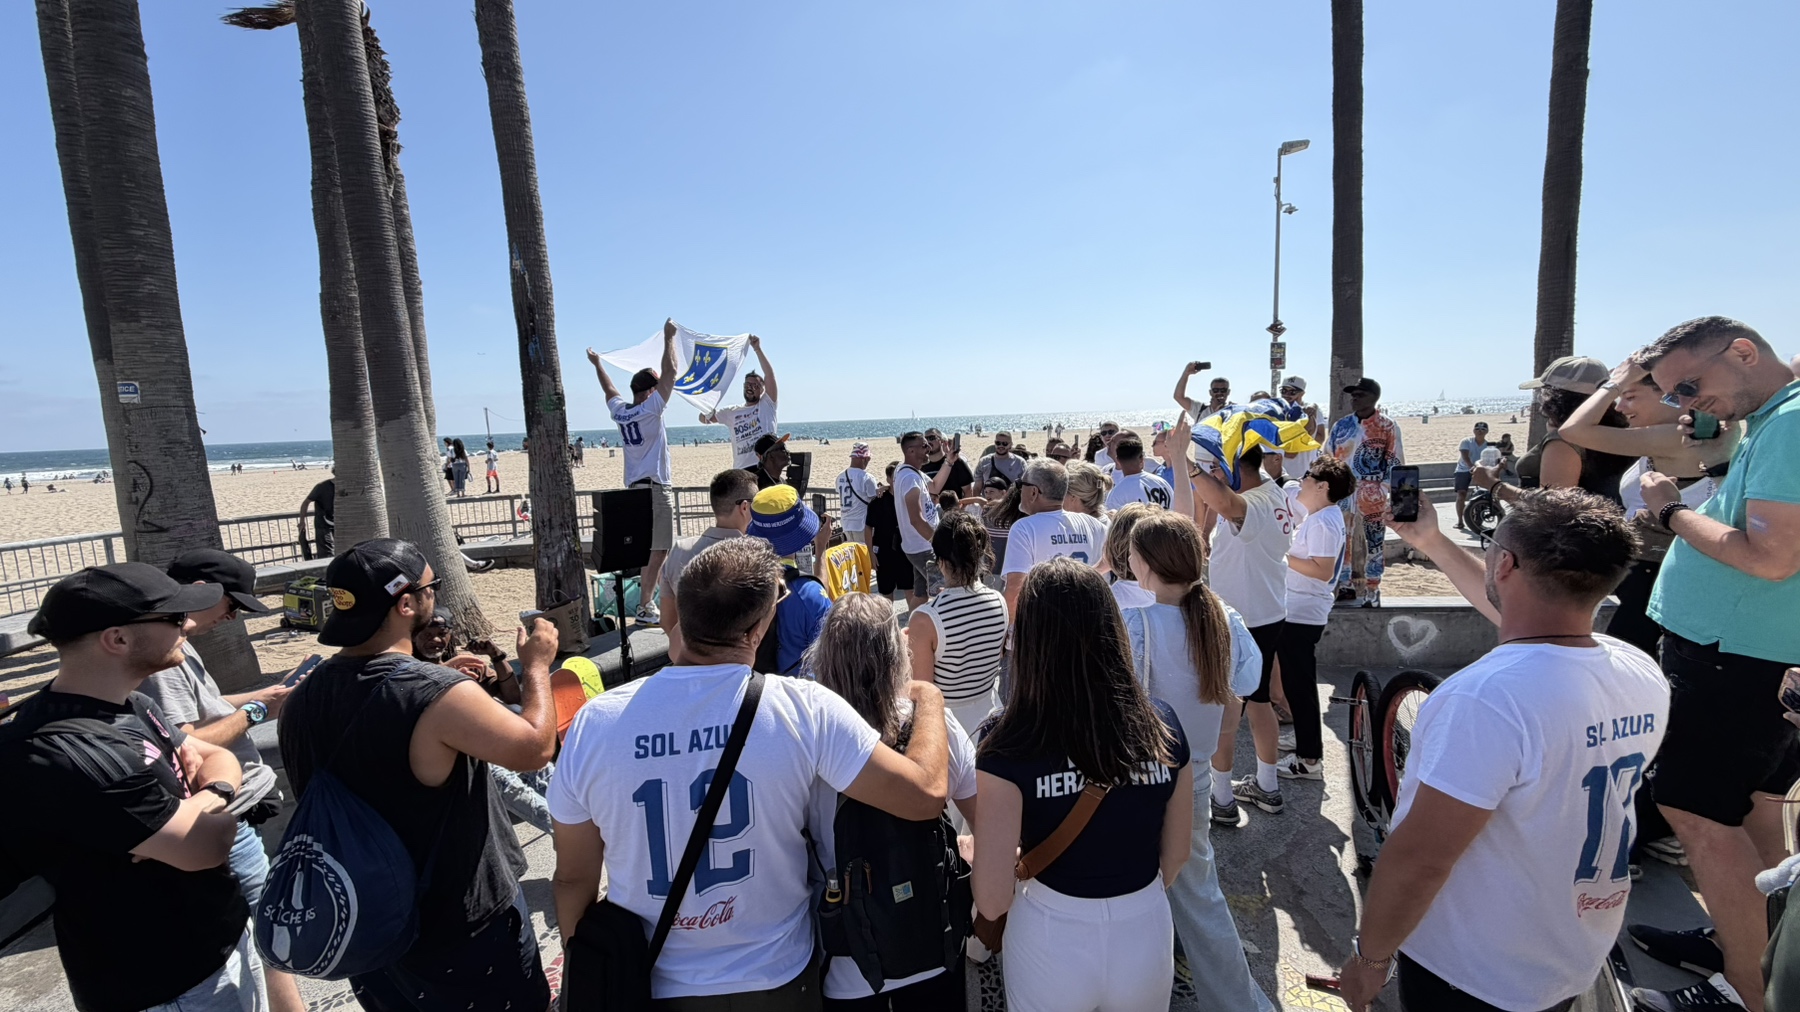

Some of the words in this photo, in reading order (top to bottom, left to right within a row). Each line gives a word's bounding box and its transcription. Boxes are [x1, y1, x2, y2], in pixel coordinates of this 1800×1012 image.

[620, 421, 643, 446] 10
[838, 485, 853, 507] 12
[1051, 535, 1070, 545] SOL
[1069, 533, 1088, 544] AZUR
[842, 563, 859, 590] 44
[634, 731, 681, 759] SOL
[688, 723, 734, 753] AZU
[1586, 721, 1607, 748] SL
[1612, 713, 1655, 741] AZUR
[632, 768, 755, 900] 12
